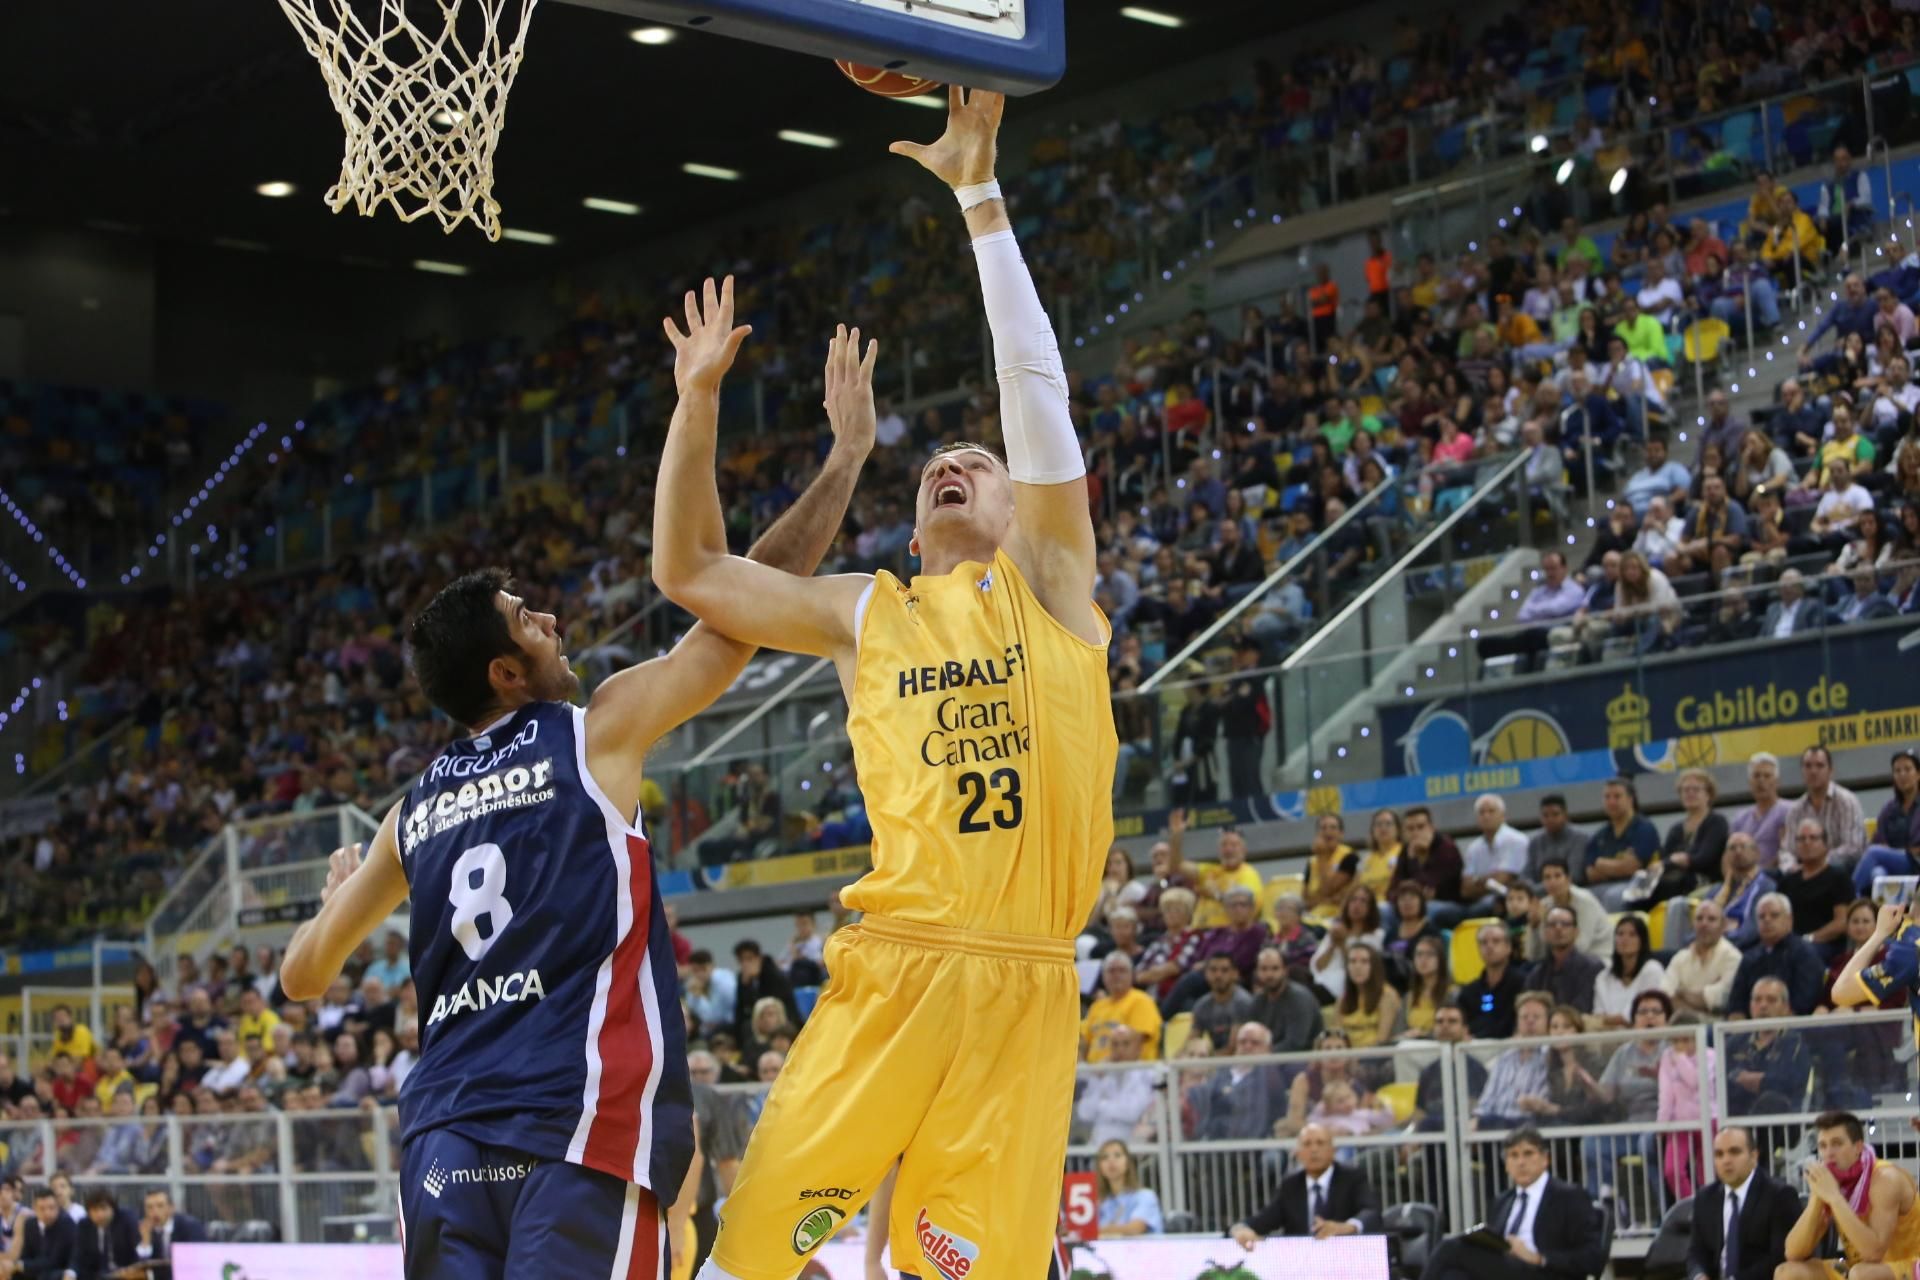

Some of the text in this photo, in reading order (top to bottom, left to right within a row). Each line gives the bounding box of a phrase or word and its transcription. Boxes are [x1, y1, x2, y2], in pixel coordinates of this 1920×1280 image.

[937, 696, 1011, 732] Gran
[1675, 675, 1848, 731] Cabildo de
[1818, 713, 1920, 746] GRAN CANARI
[434, 788, 554, 835] electrodomésticos
[435, 759, 551, 817] cenor
[957, 767, 1023, 834] 23
[448, 842, 514, 962] 8
[426, 969, 546, 1026] AVANCA
[1069, 1183, 1095, 1226] 5
